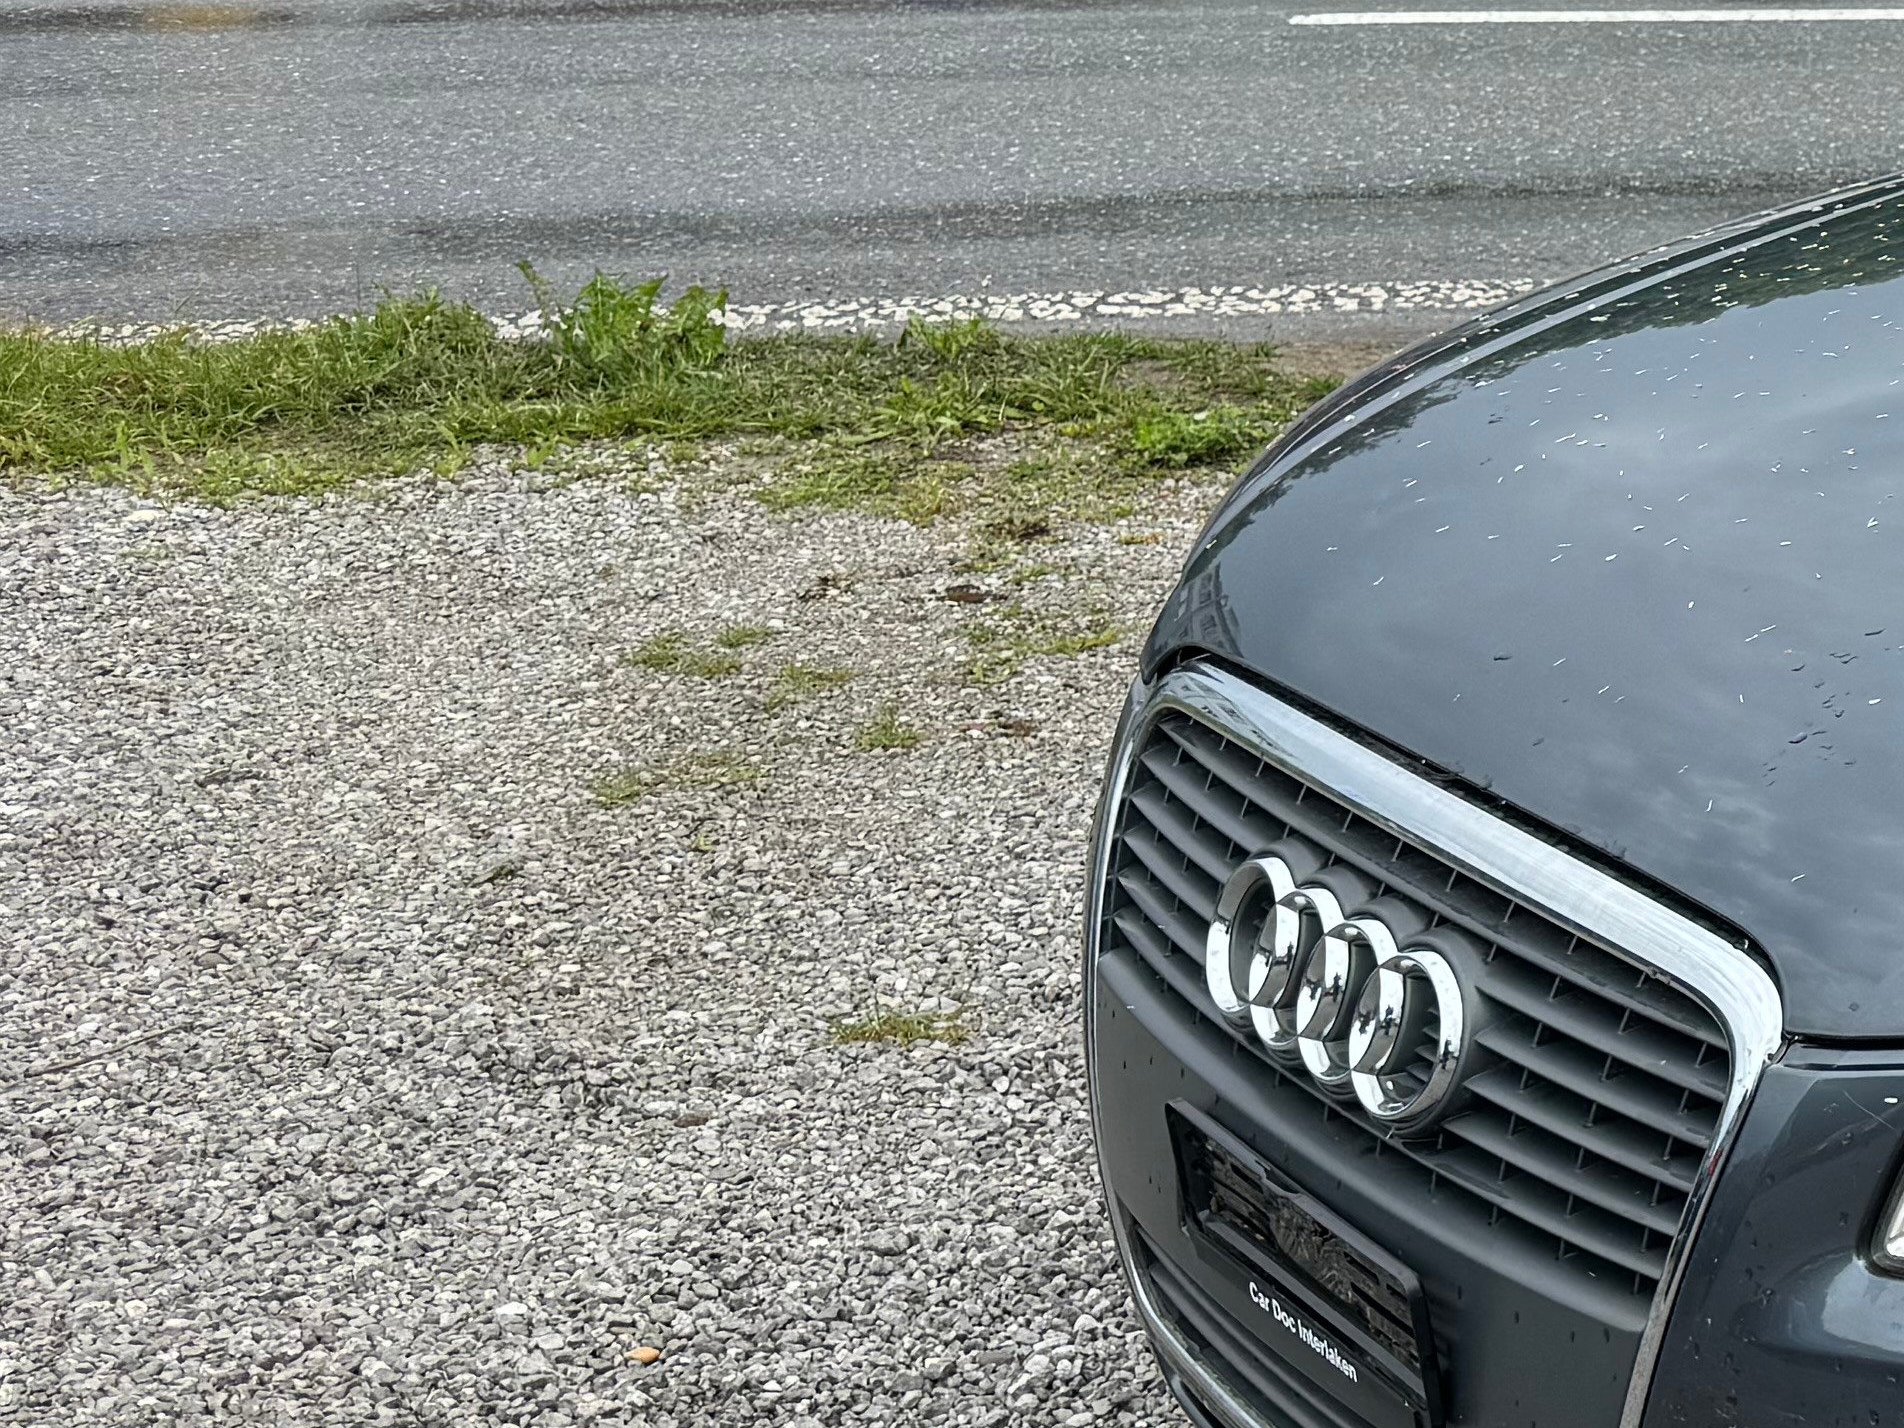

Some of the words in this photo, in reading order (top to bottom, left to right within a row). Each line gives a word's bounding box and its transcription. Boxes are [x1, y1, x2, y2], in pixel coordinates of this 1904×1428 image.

[1249, 1281, 1270, 1312] Car
[1272, 1298, 1297, 1333] Doc
[1297, 1319, 1358, 1383] Interlaken
